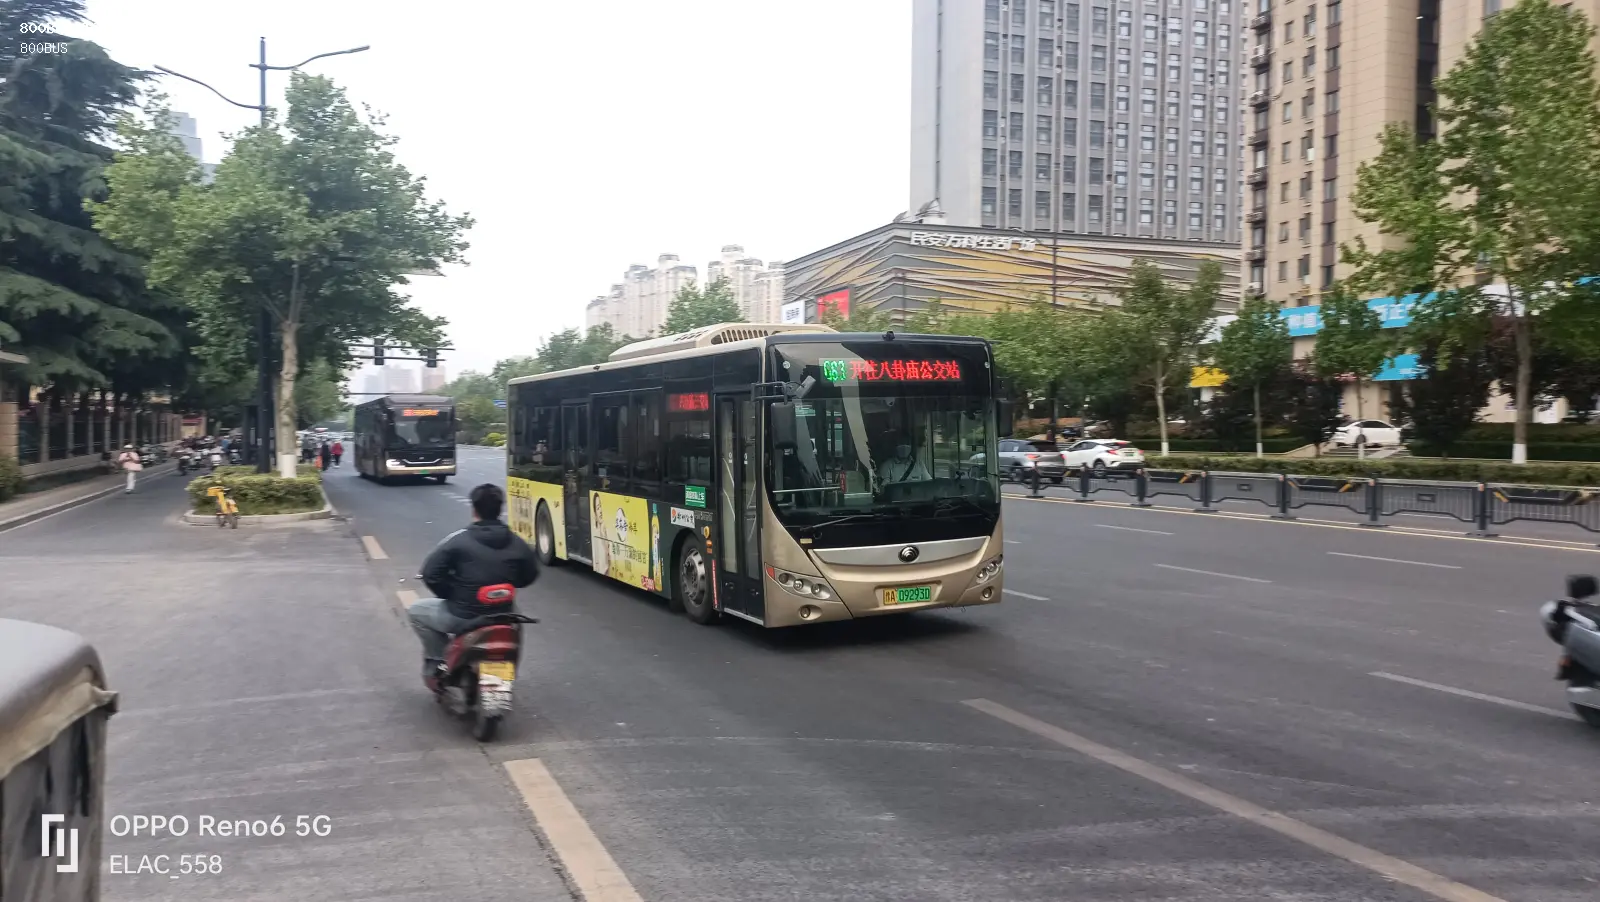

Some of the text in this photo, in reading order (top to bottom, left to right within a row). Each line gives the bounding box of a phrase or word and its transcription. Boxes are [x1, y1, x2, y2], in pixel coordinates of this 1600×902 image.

[911, 231, 1037, 251] 民安万科生活广场
[850, 359, 961, 381] 开往八卦庙公交站
